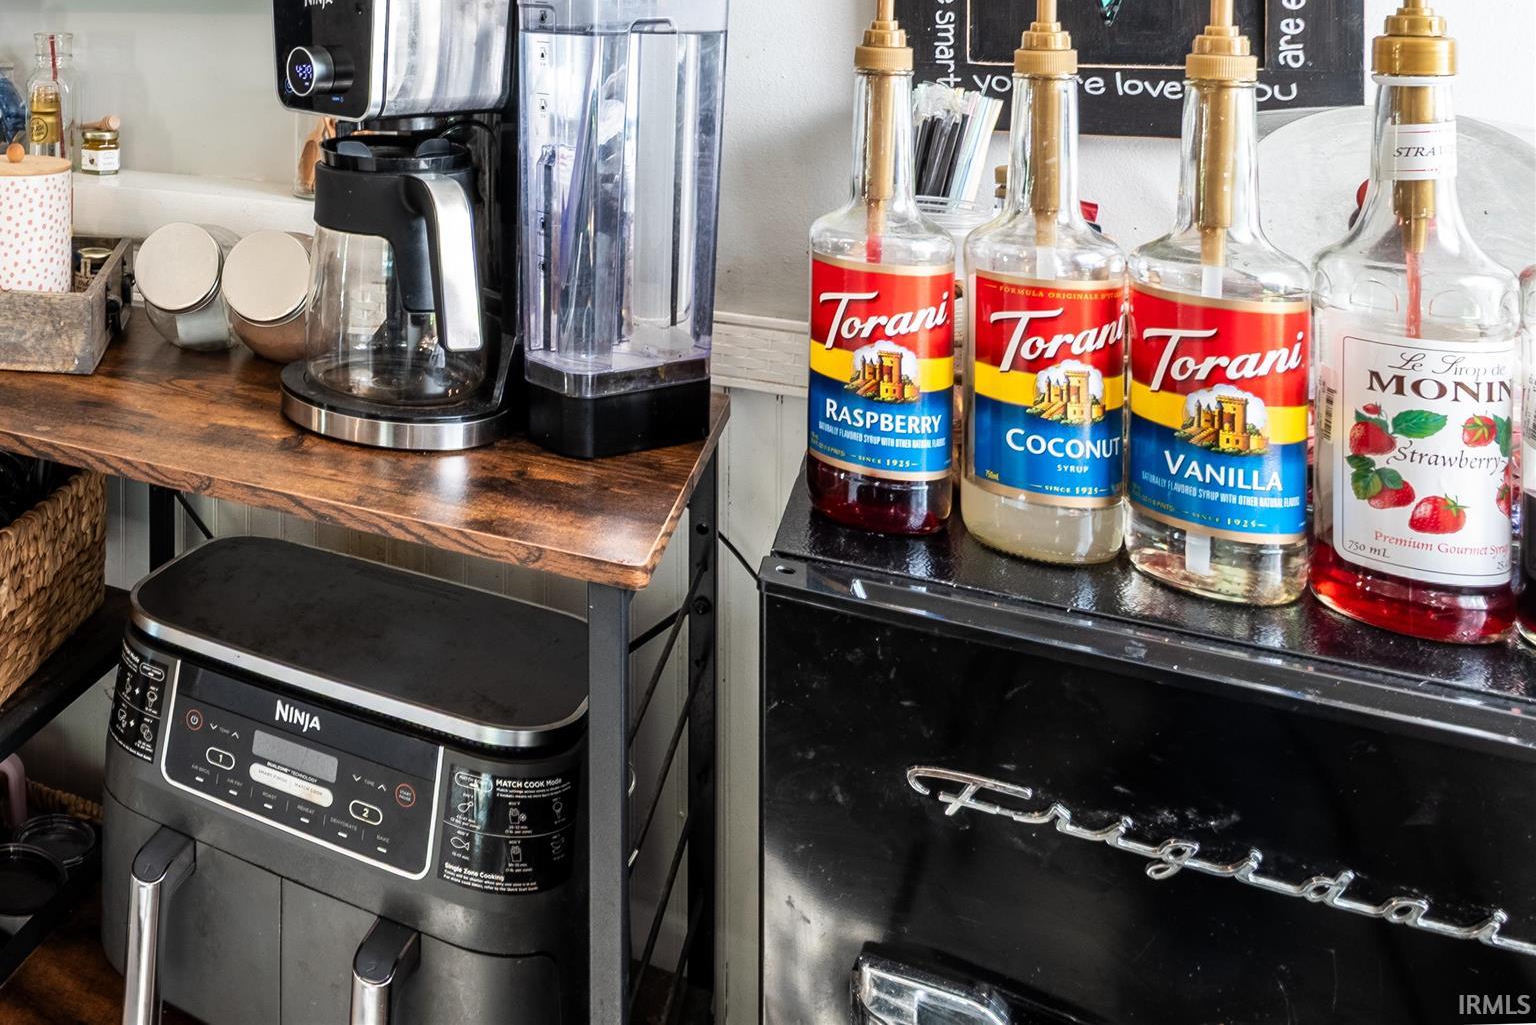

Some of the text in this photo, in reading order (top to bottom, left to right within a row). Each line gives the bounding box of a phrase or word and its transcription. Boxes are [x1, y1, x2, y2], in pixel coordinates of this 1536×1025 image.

[932, 10, 965, 87] smart
[1276, 20, 1306, 69] are
[1116, 71, 1185, 100] love
[1392, 146, 1443, 158] STRA
[999, 285, 1045, 298] FORMULA
[819, 290, 950, 351] Torani
[1142, 327, 1304, 393] Torani
[1387, 351, 1426, 372] Le
[1431, 354, 1487, 381] Sirop
[1366, 369, 1512, 404] MONIN
[825, 397, 943, 435] RASPBERRY
[864, 434, 881, 445] SYRUP
[1005, 428, 1121, 460] COCONUT
[1057, 464, 1089, 474] SYRUP
[1163, 450, 1284, 492] VANILLA
[1385, 439, 1508, 477] Strawberry
[1044, 484, 1071, 494] SINCE
[1167, 479, 1197, 498] FLAVORED
[1197, 488, 1220, 502] SYRUP
[1220, 493, 1237, 504] WITH
[1238, 495, 1259, 507] OTHER
[1348, 539, 1391, 559] 750 mL
[1374, 529, 1434, 552] Premium
[1437, 542, 1488, 555] Gourmet
[275, 699, 321, 733] NINJA
[496, 779, 523, 789] MATCH
[523, 779, 545, 789] COOK
[362, 808, 370, 818] 2
[444, 861, 463, 874] Single
[463, 867, 479, 878] Zone
[479, 871, 505, 882] Cooking
